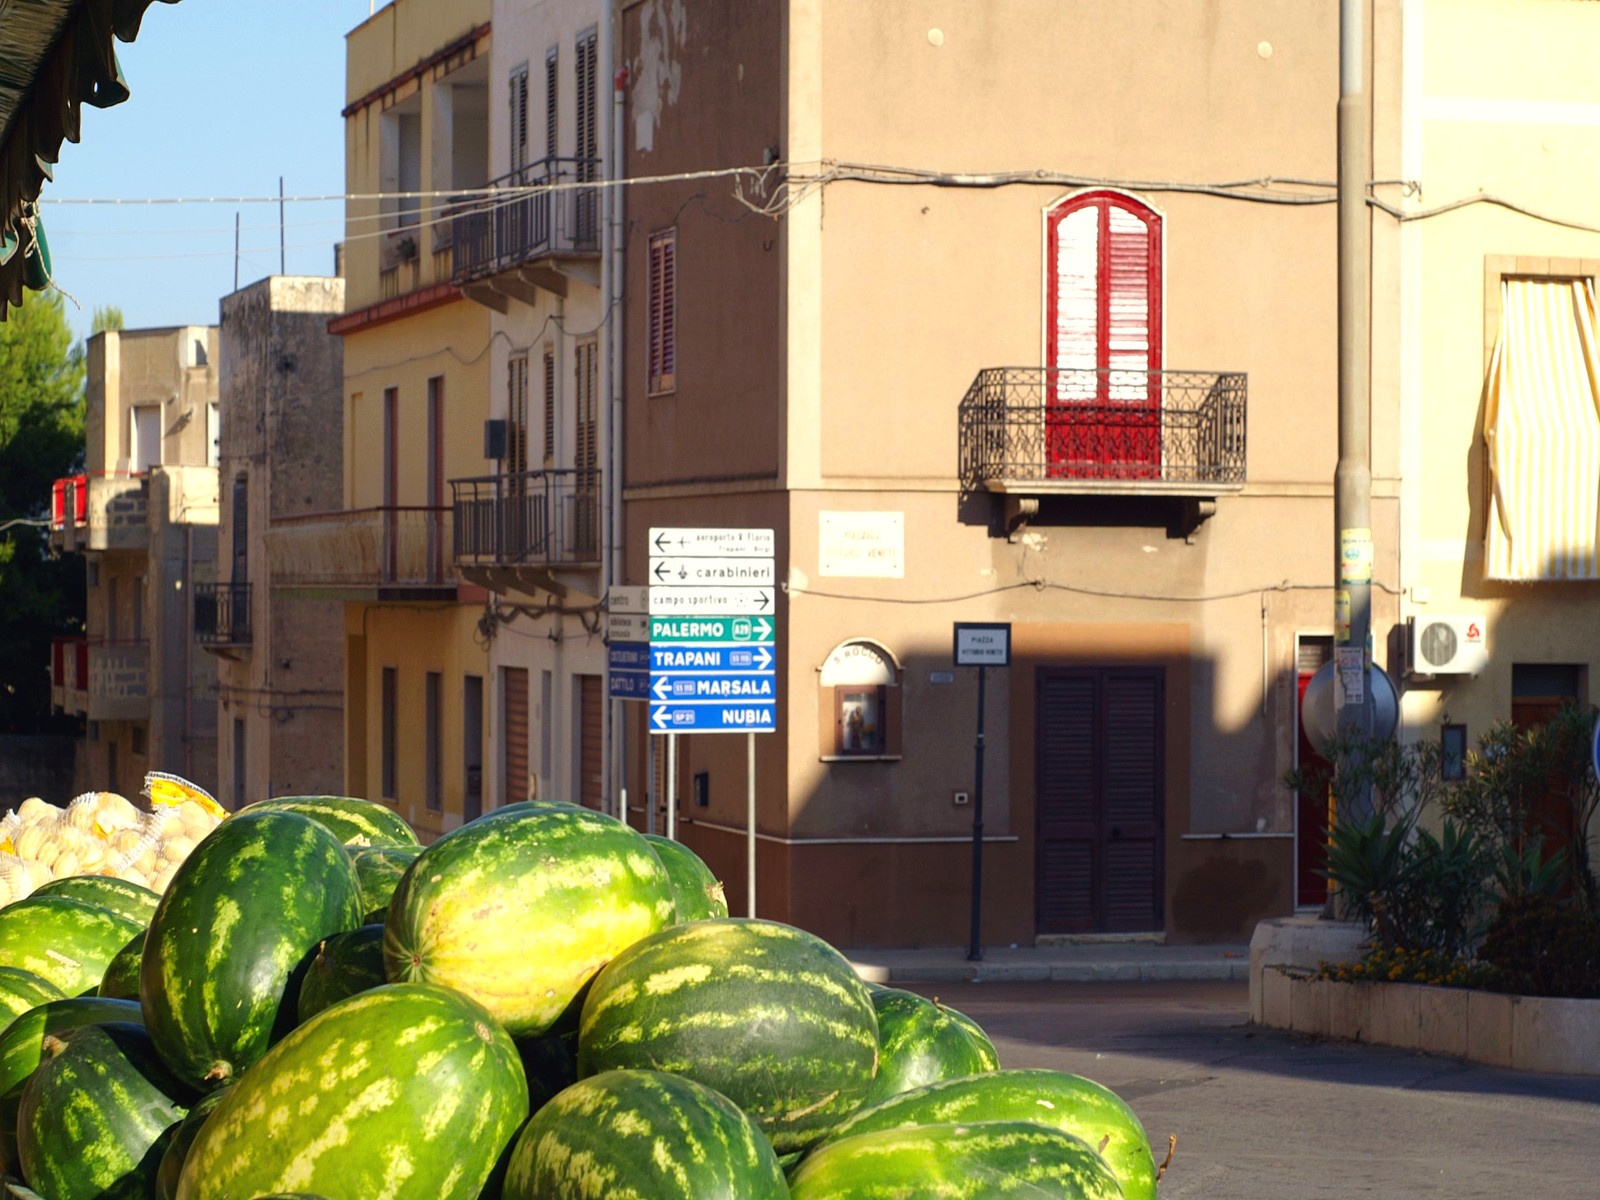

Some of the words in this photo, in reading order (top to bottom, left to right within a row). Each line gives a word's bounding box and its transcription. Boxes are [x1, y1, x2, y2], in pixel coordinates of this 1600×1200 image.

[696, 566, 770, 578] carabinieri
[653, 597, 684, 606] campo
[688, 595, 728, 606] sportivo
[652, 623, 724, 637] PALERMO
[653, 651, 721, 666] TRAPANI
[844, 647, 883, 665] ROCCO
[697, 680, 771, 695] MARSALA
[722, 709, 772, 724] NUBIA
